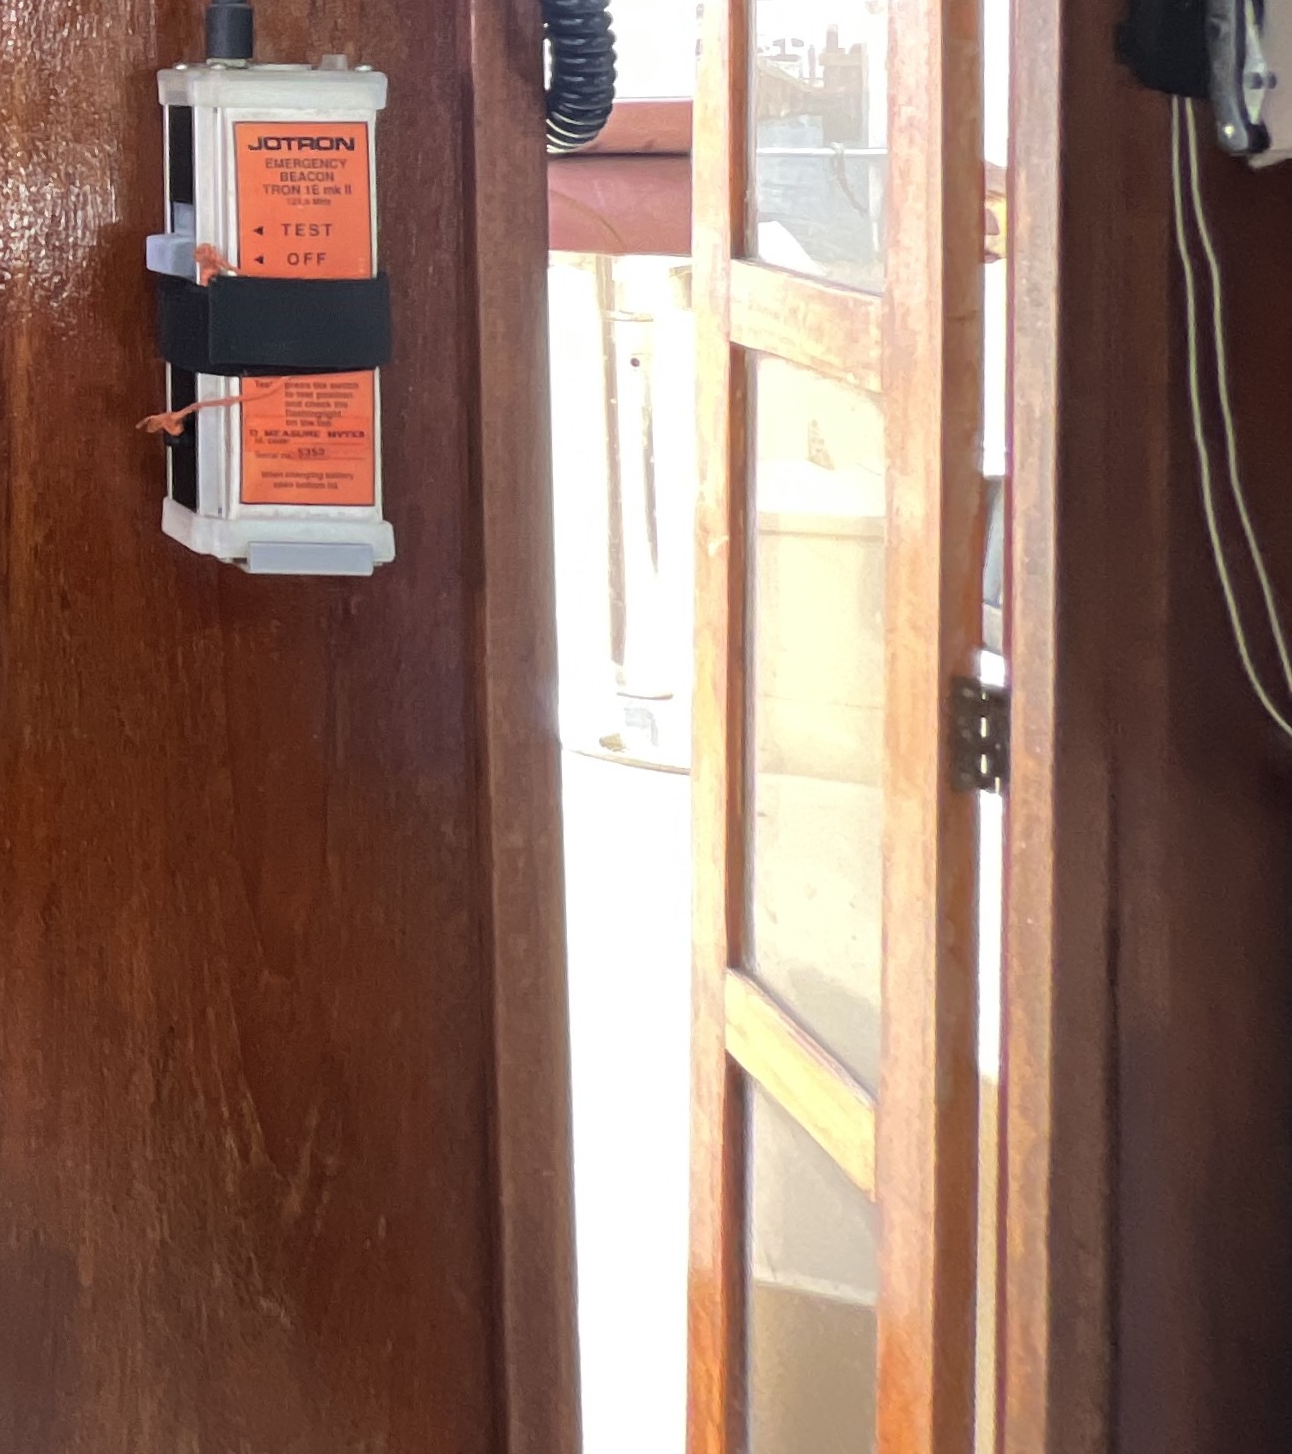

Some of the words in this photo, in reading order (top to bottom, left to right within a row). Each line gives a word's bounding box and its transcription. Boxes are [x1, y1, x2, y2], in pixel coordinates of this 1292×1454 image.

[248, 136, 355, 152] JOTRON
[265, 158, 347, 169] EMERGENCY
[280, 171, 334, 182] BEACON
[263, 184, 301, 195] TRON
[306, 184, 320, 195] 1E
[323, 184, 341, 195] mk
[281, 223, 333, 237] TEST
[287, 252, 327, 266] OFF
